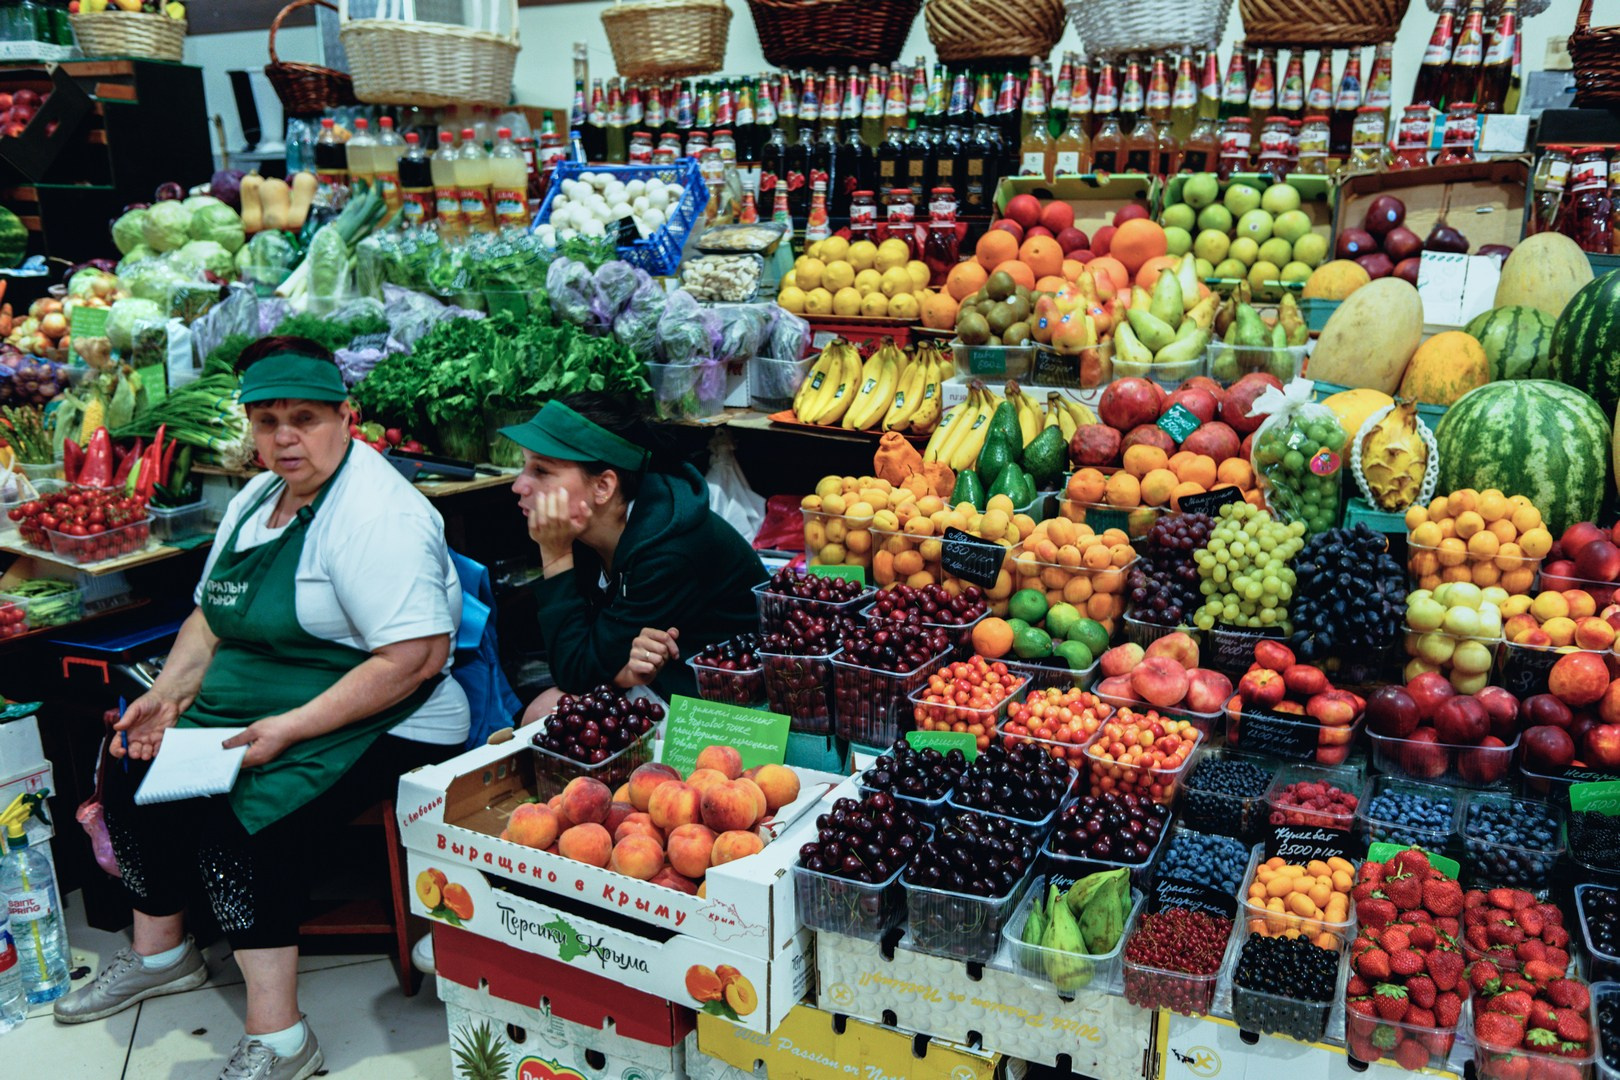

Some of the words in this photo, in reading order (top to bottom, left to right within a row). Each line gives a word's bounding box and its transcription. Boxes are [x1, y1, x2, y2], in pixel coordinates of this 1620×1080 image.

[208, 593, 239, 606] РЫНОК
[1276, 843, 1313, 856] 2500
[436, 833, 557, 884] Выращено
[575, 879, 584, 891] в
[602, 884, 687, 927] Крыму
[496, 902, 567, 946] Персики
[576, 933, 650, 975] Крыма
[971, 996, 1046, 1028] Passion
[1051, 1015, 1102, 1042] With
[732, 1024, 772, 1048] With
[777, 1036, 840, 1073] Passion
[843, 1064, 860, 1076] or
